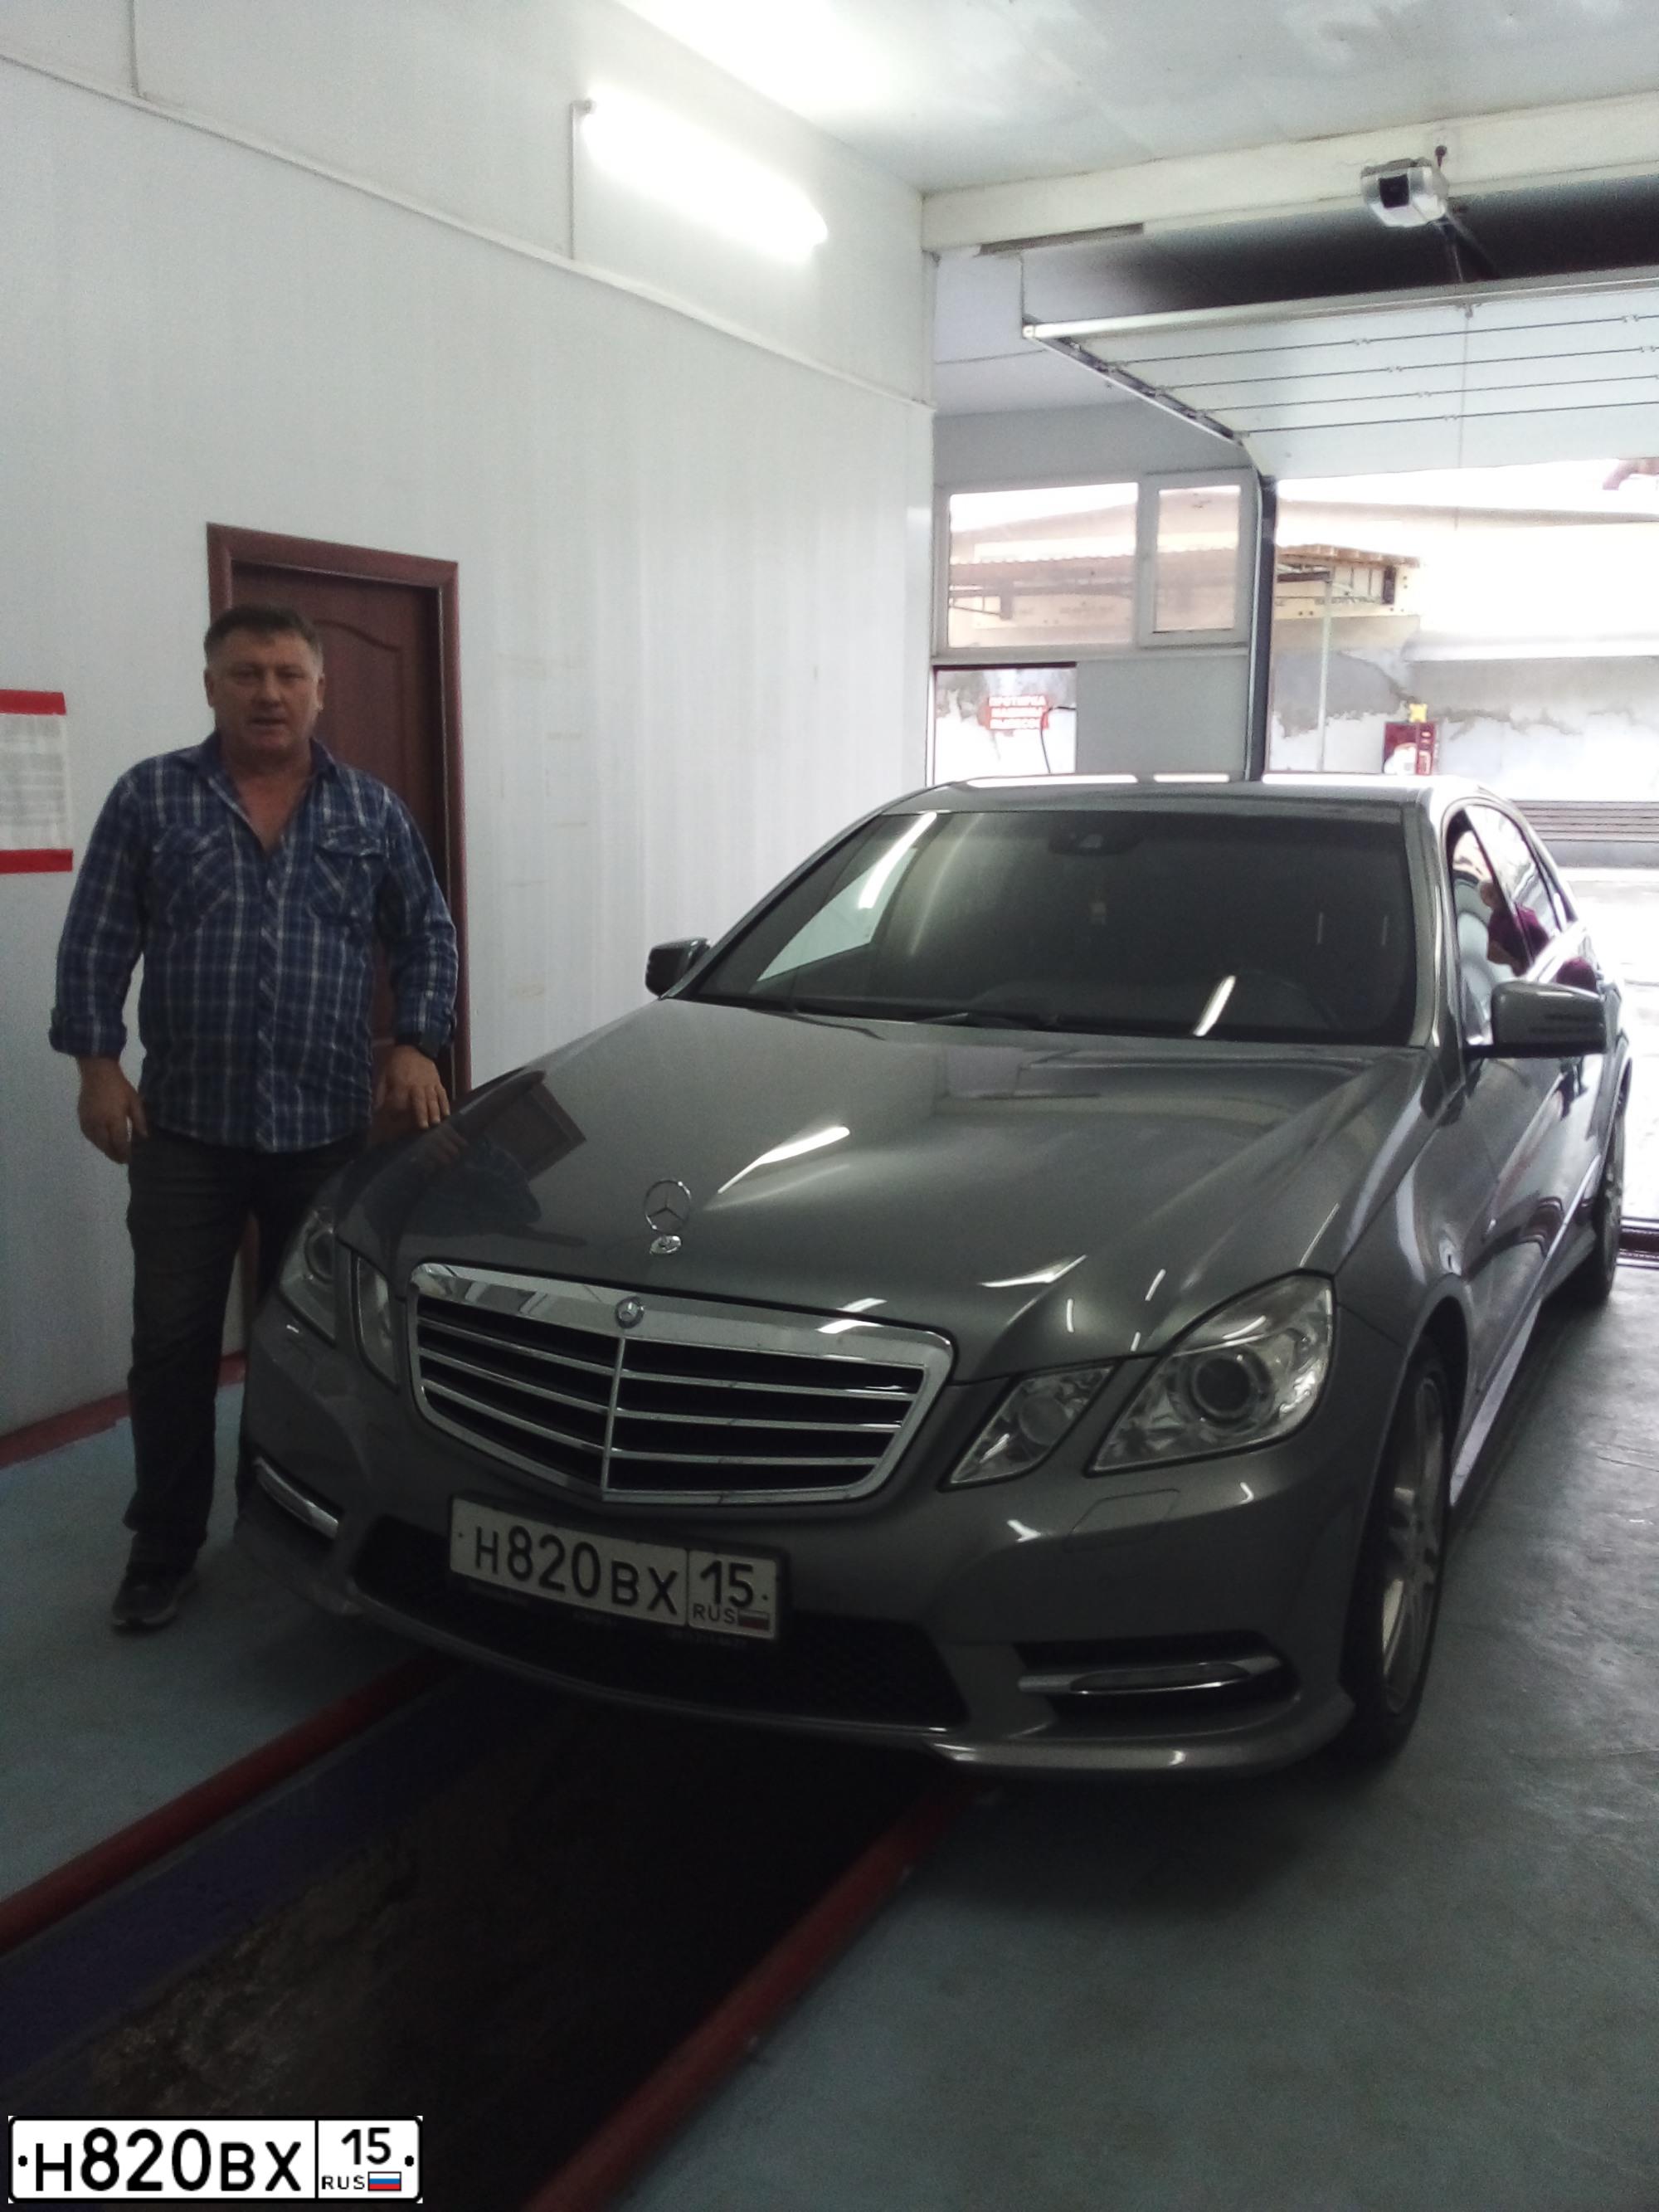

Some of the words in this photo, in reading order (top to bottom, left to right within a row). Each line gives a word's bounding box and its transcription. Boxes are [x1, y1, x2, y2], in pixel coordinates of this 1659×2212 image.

[474, 1525, 678, 1615] Н820ВХ
[700, 1560, 754, 1608] 15
[692, 1602, 737, 1624] RUS
